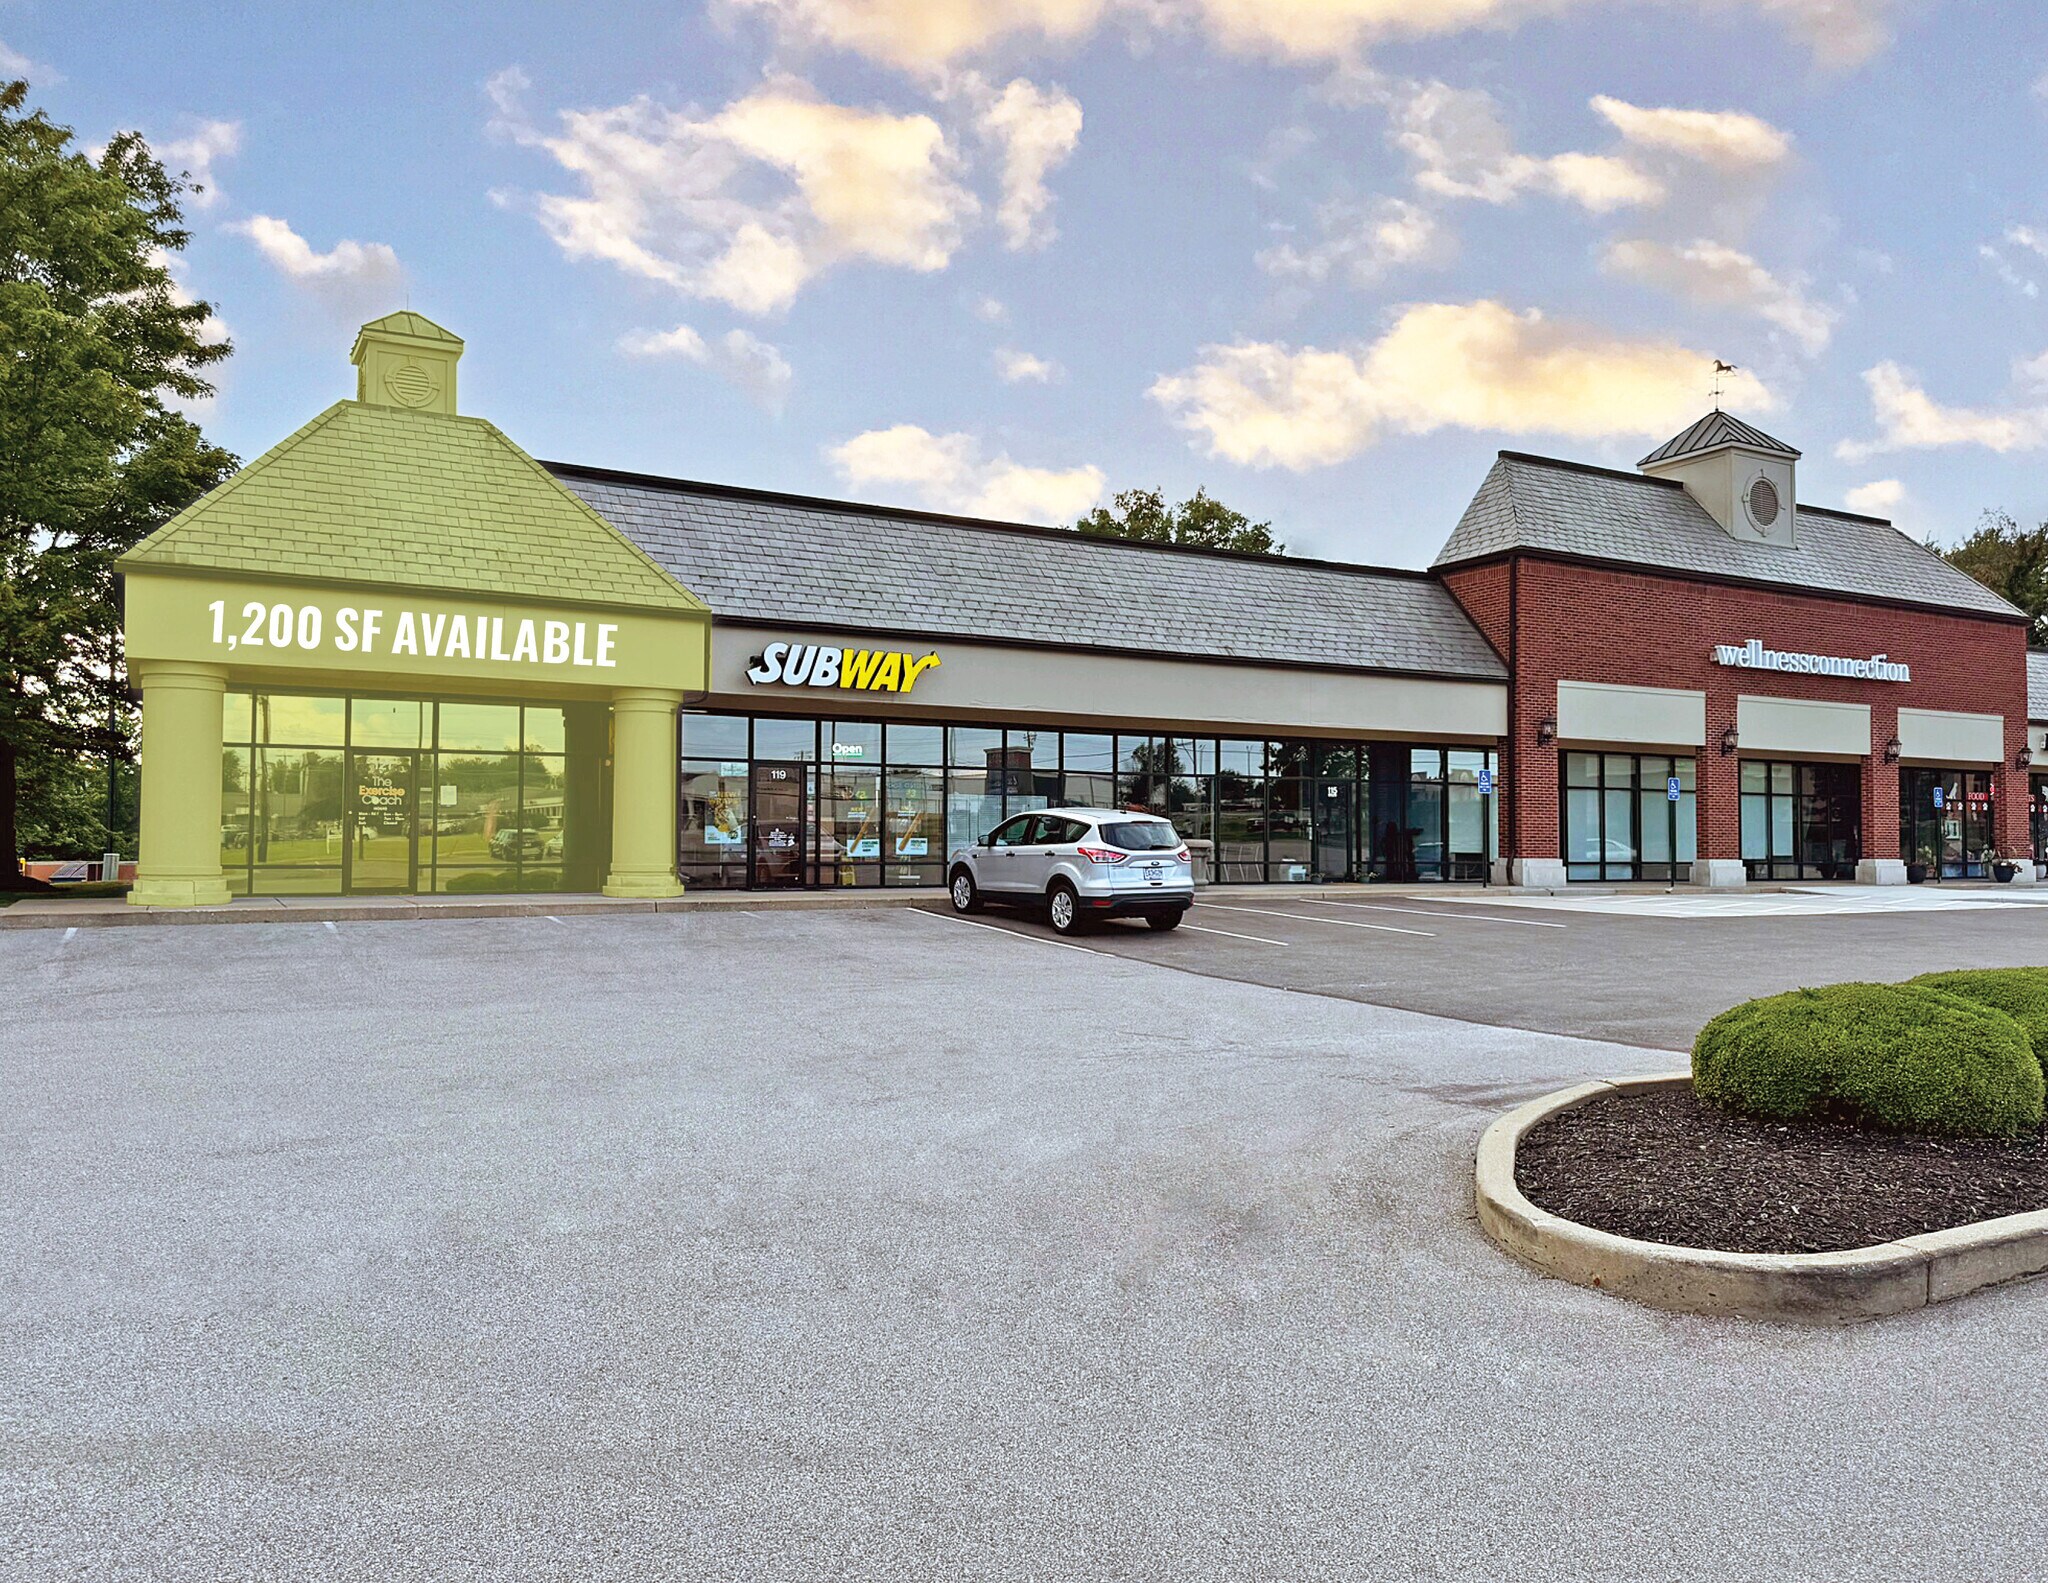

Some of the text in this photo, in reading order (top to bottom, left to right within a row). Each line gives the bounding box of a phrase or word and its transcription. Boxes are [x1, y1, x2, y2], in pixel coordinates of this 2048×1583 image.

[1715, 639, 1911, 682] wellnessconnection
[746, 642, 941, 693] SUBWAY
[832, 743, 862, 756] Open
[771, 770, 787, 780] 119
[372, 776, 392, 786] The
[359, 785, 405, 796] Exercise
[362, 795, 402, 805] Coach
[1968, 792, 1985, 800] FOOD
